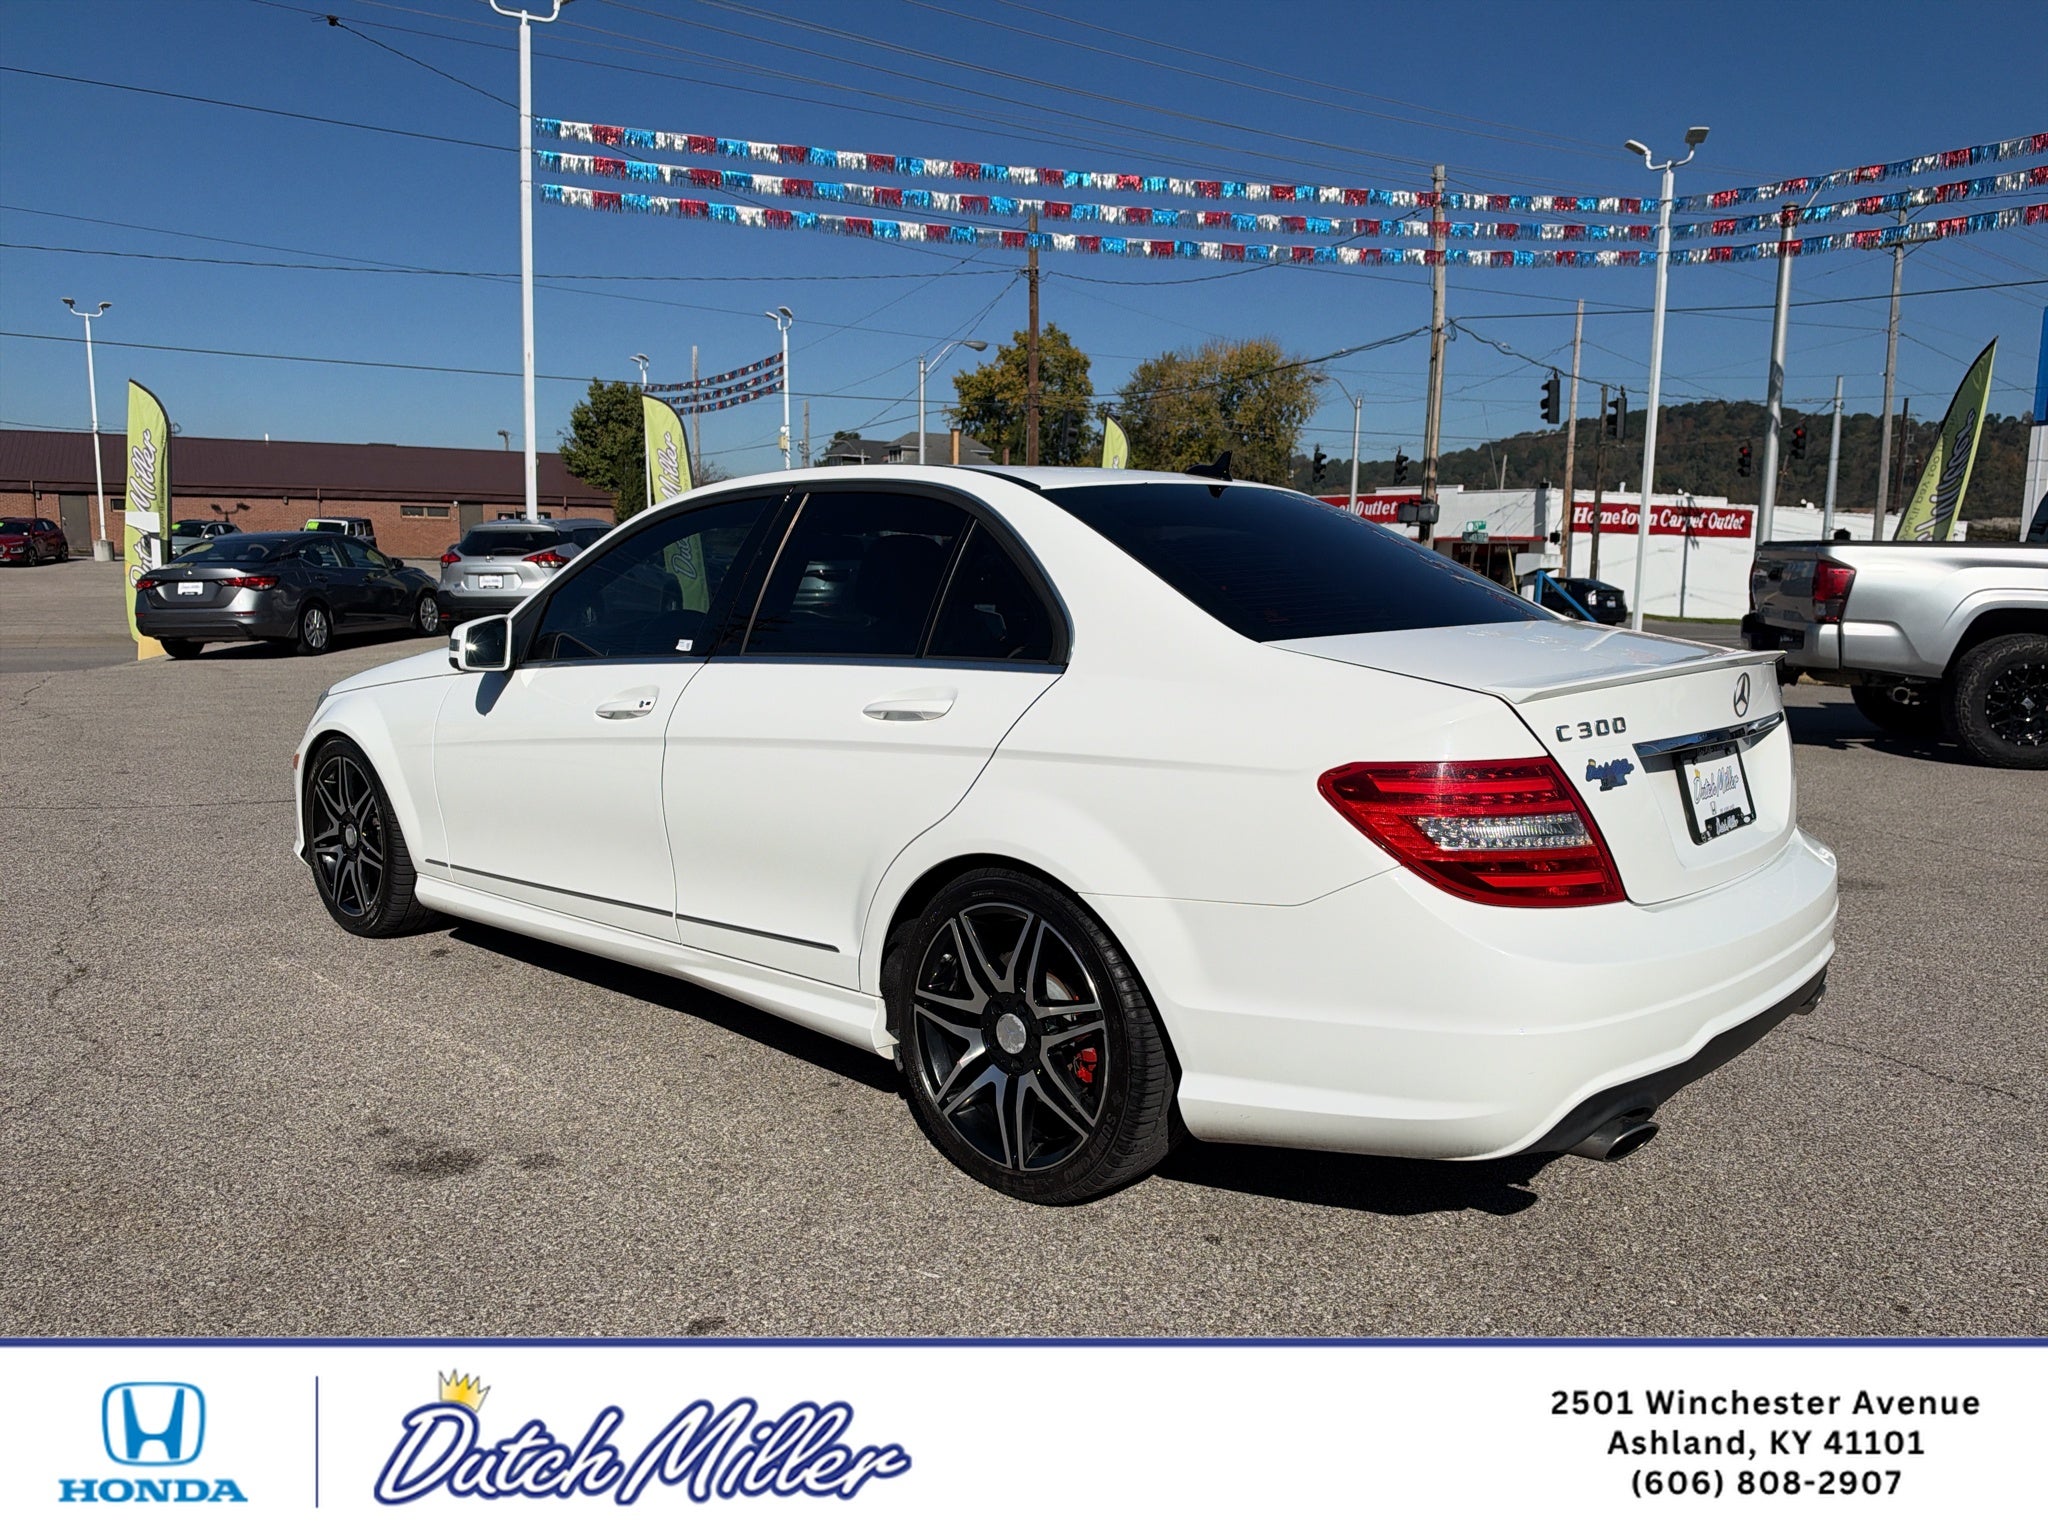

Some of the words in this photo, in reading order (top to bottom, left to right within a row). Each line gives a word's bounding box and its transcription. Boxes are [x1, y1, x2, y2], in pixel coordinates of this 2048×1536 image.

[129, 427, 159, 512] Miller
[656, 431, 682, 500] Miller
[1355, 500, 1399, 516] Outlet
[1572, 506, 1658, 526] Hometon
[1659, 508, 1706, 532] Carpet
[1708, 511, 1746, 531] Outlet
[128, 528, 153, 588] Dut
